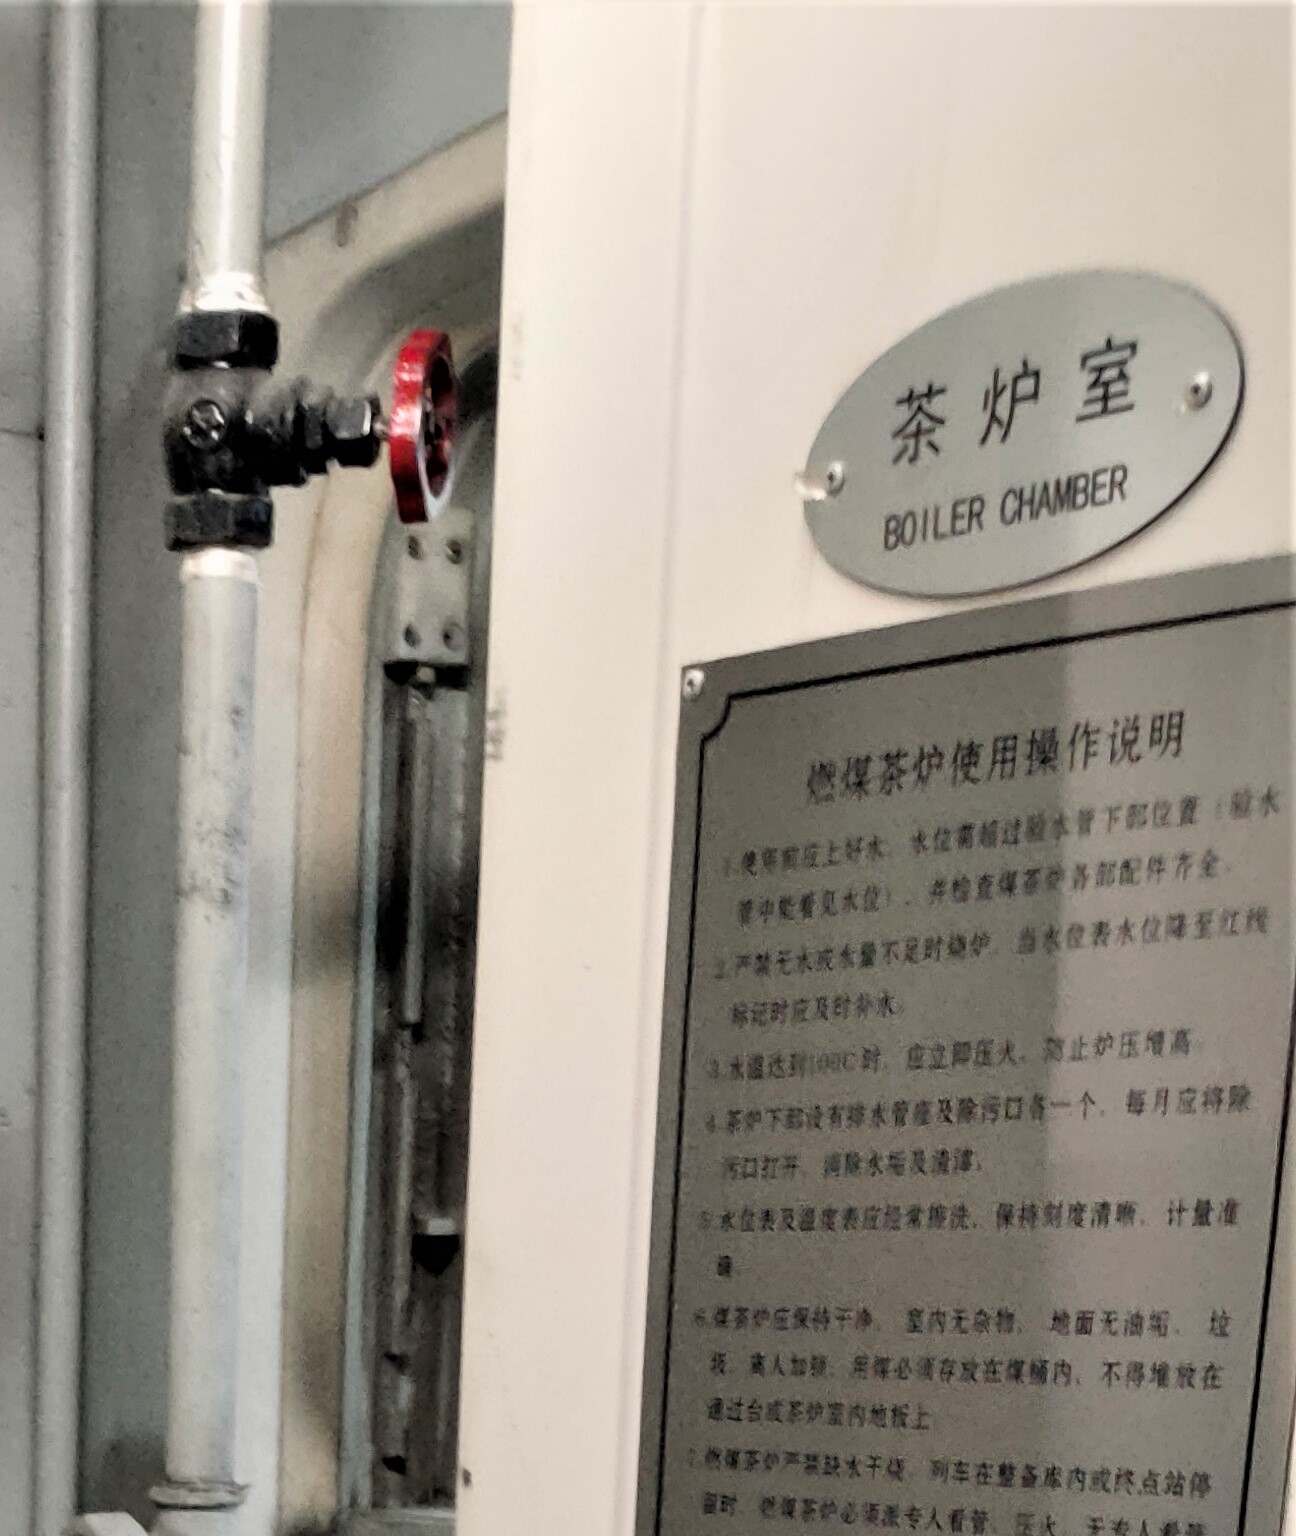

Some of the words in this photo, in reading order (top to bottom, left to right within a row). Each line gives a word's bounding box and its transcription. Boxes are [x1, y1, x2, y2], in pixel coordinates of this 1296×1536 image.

[891, 331, 1138, 466] 茶炉室
[883, 497, 985, 551] BOILER
[999, 463, 1129, 526] CHAMBER
[804, 707, 1188, 806] 燃煤茶炉使用操作说明
